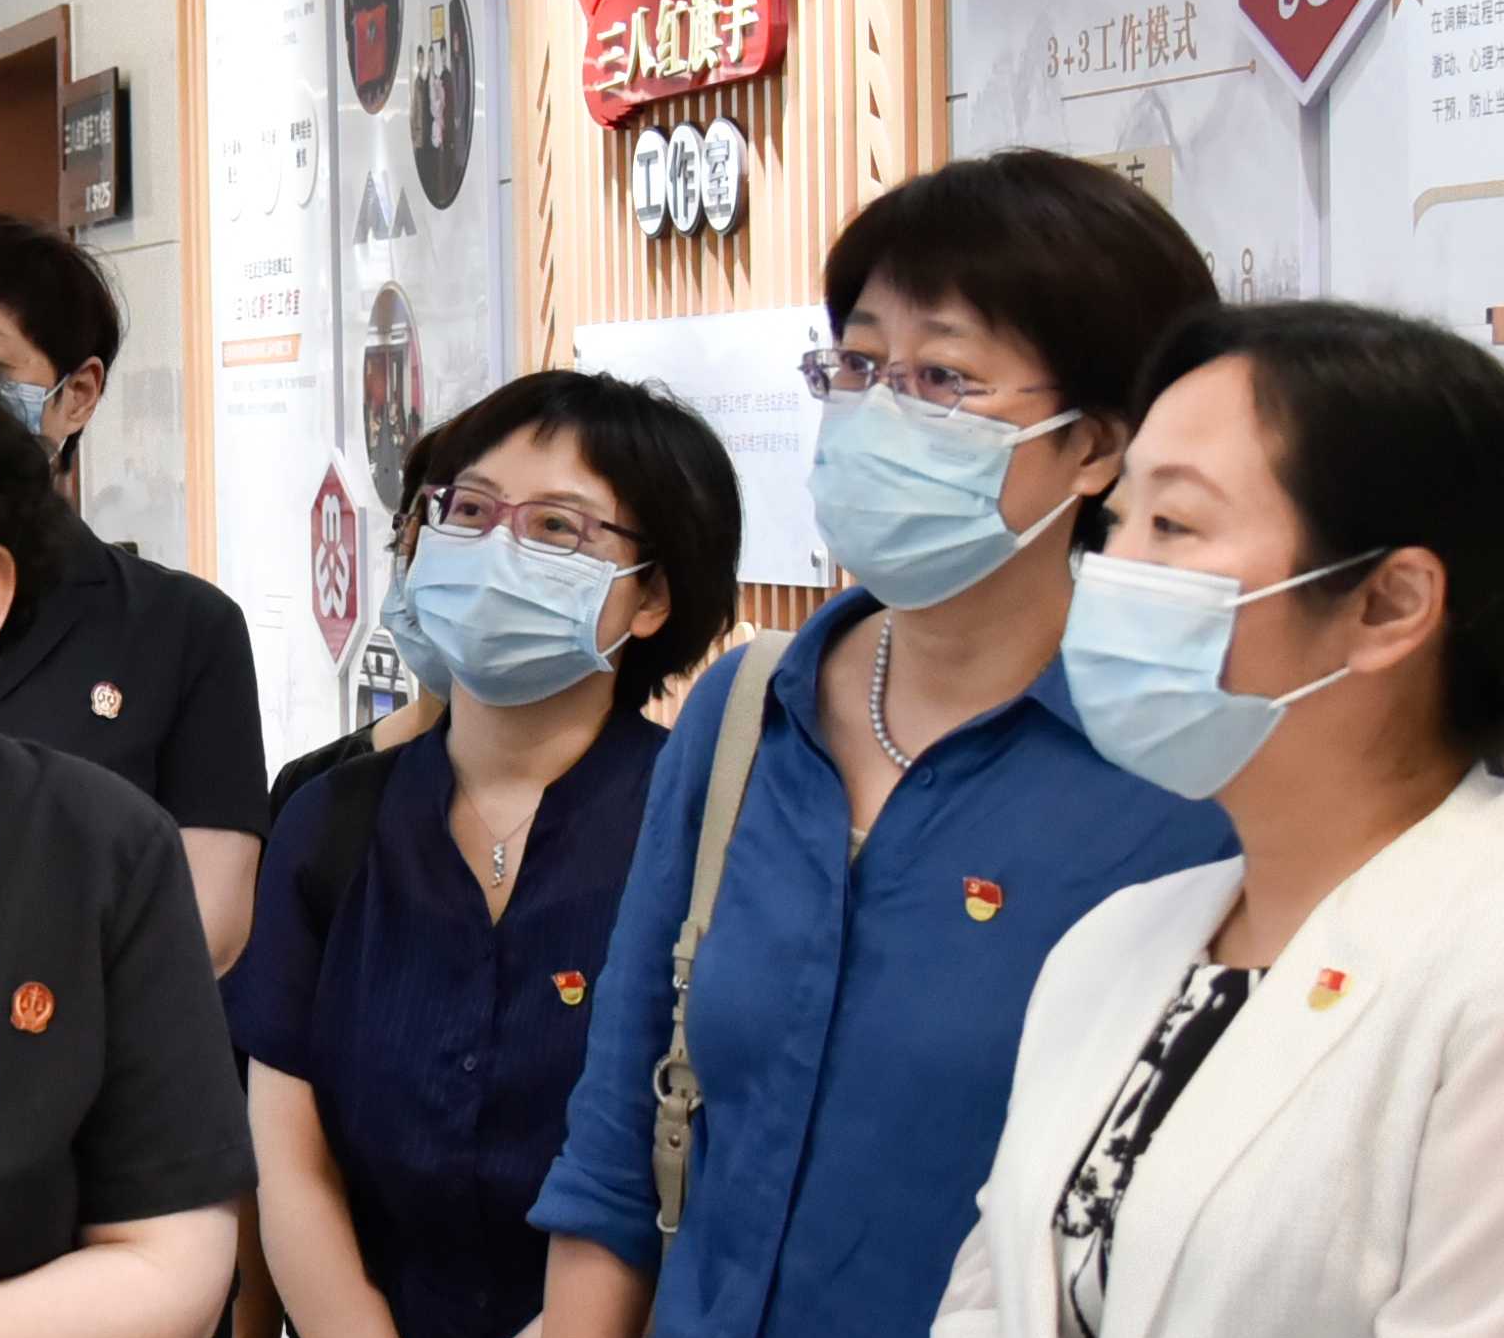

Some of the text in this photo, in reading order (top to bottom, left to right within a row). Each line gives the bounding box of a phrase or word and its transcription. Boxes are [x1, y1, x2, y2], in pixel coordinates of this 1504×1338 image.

[1047, 0, 1198, 78] 3+3工作模式
[636, 133, 733, 222] 工作室
